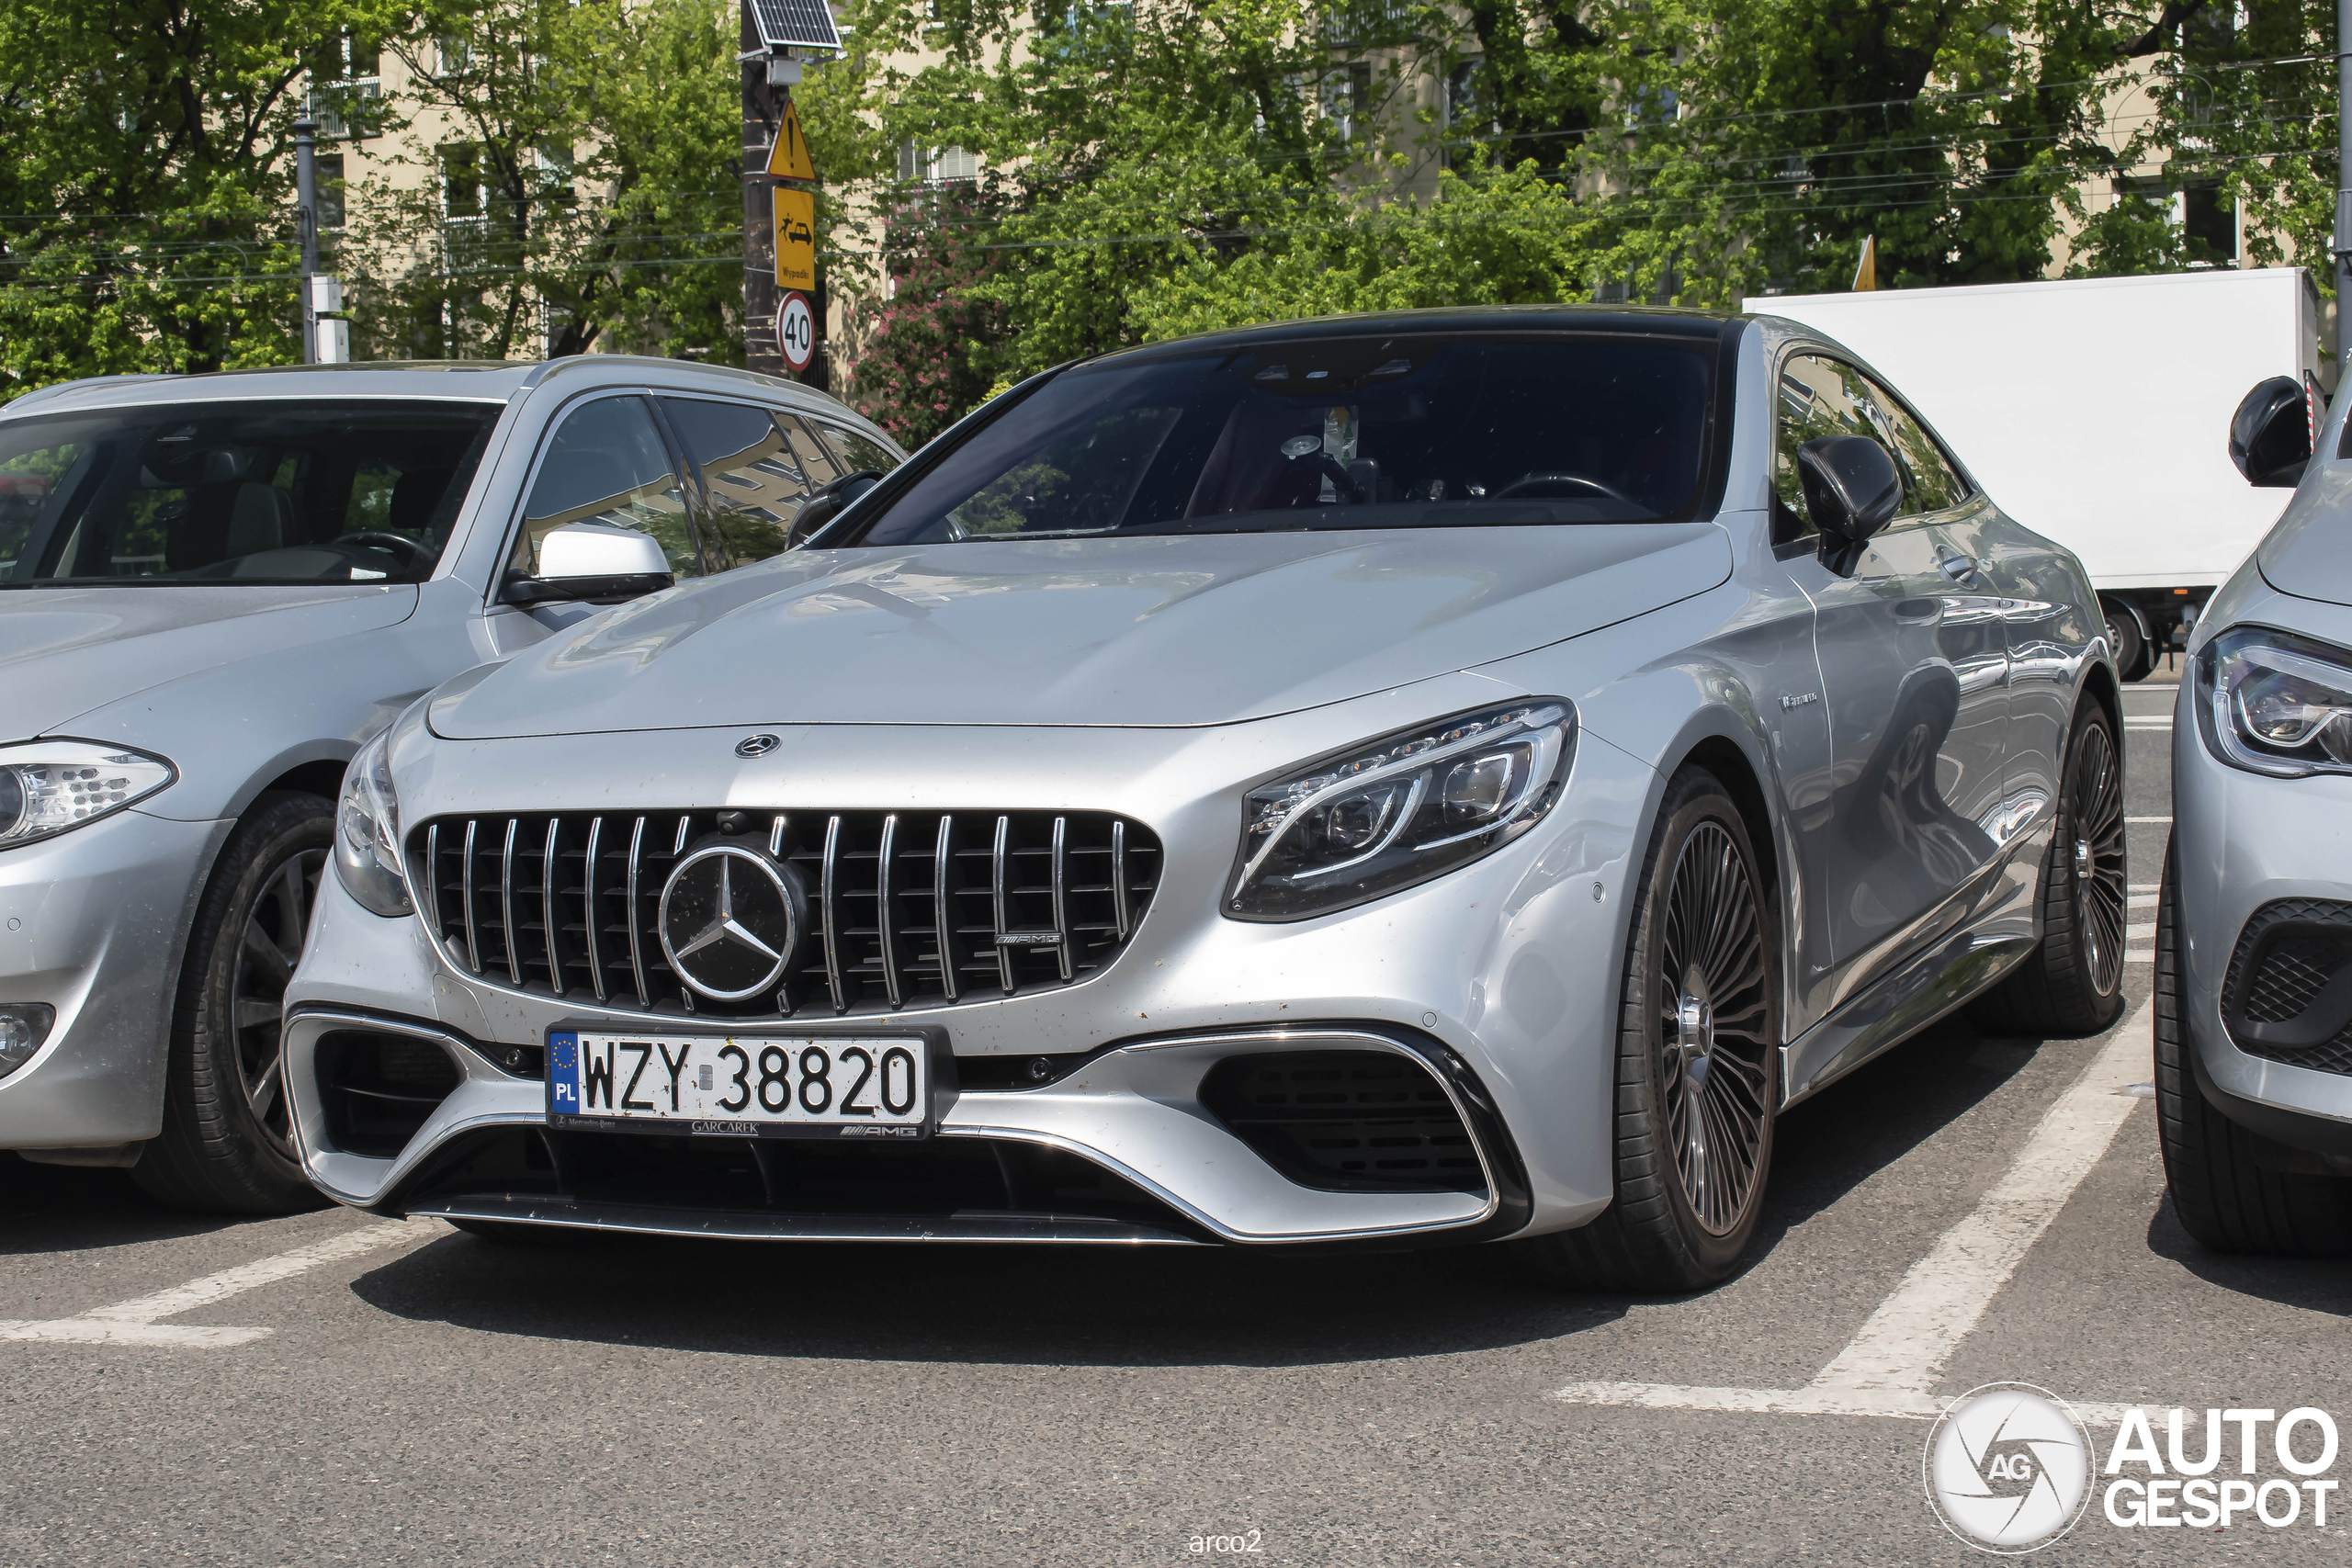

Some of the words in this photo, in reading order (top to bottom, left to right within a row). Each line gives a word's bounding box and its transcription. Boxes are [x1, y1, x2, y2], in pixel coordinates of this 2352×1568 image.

[782, 266, 809, 280] Wypadki
[785, 312, 809, 351] 40
[582, 1040, 692, 1113] WZY
[717, 1043, 917, 1116] 38820
[556, 1083, 576, 1101] PL
[569, 1117, 616, 1129] Mercedes-Benz
[692, 1121, 759, 1134] GARCAREK
[865, 1126, 917, 1136] AMG
